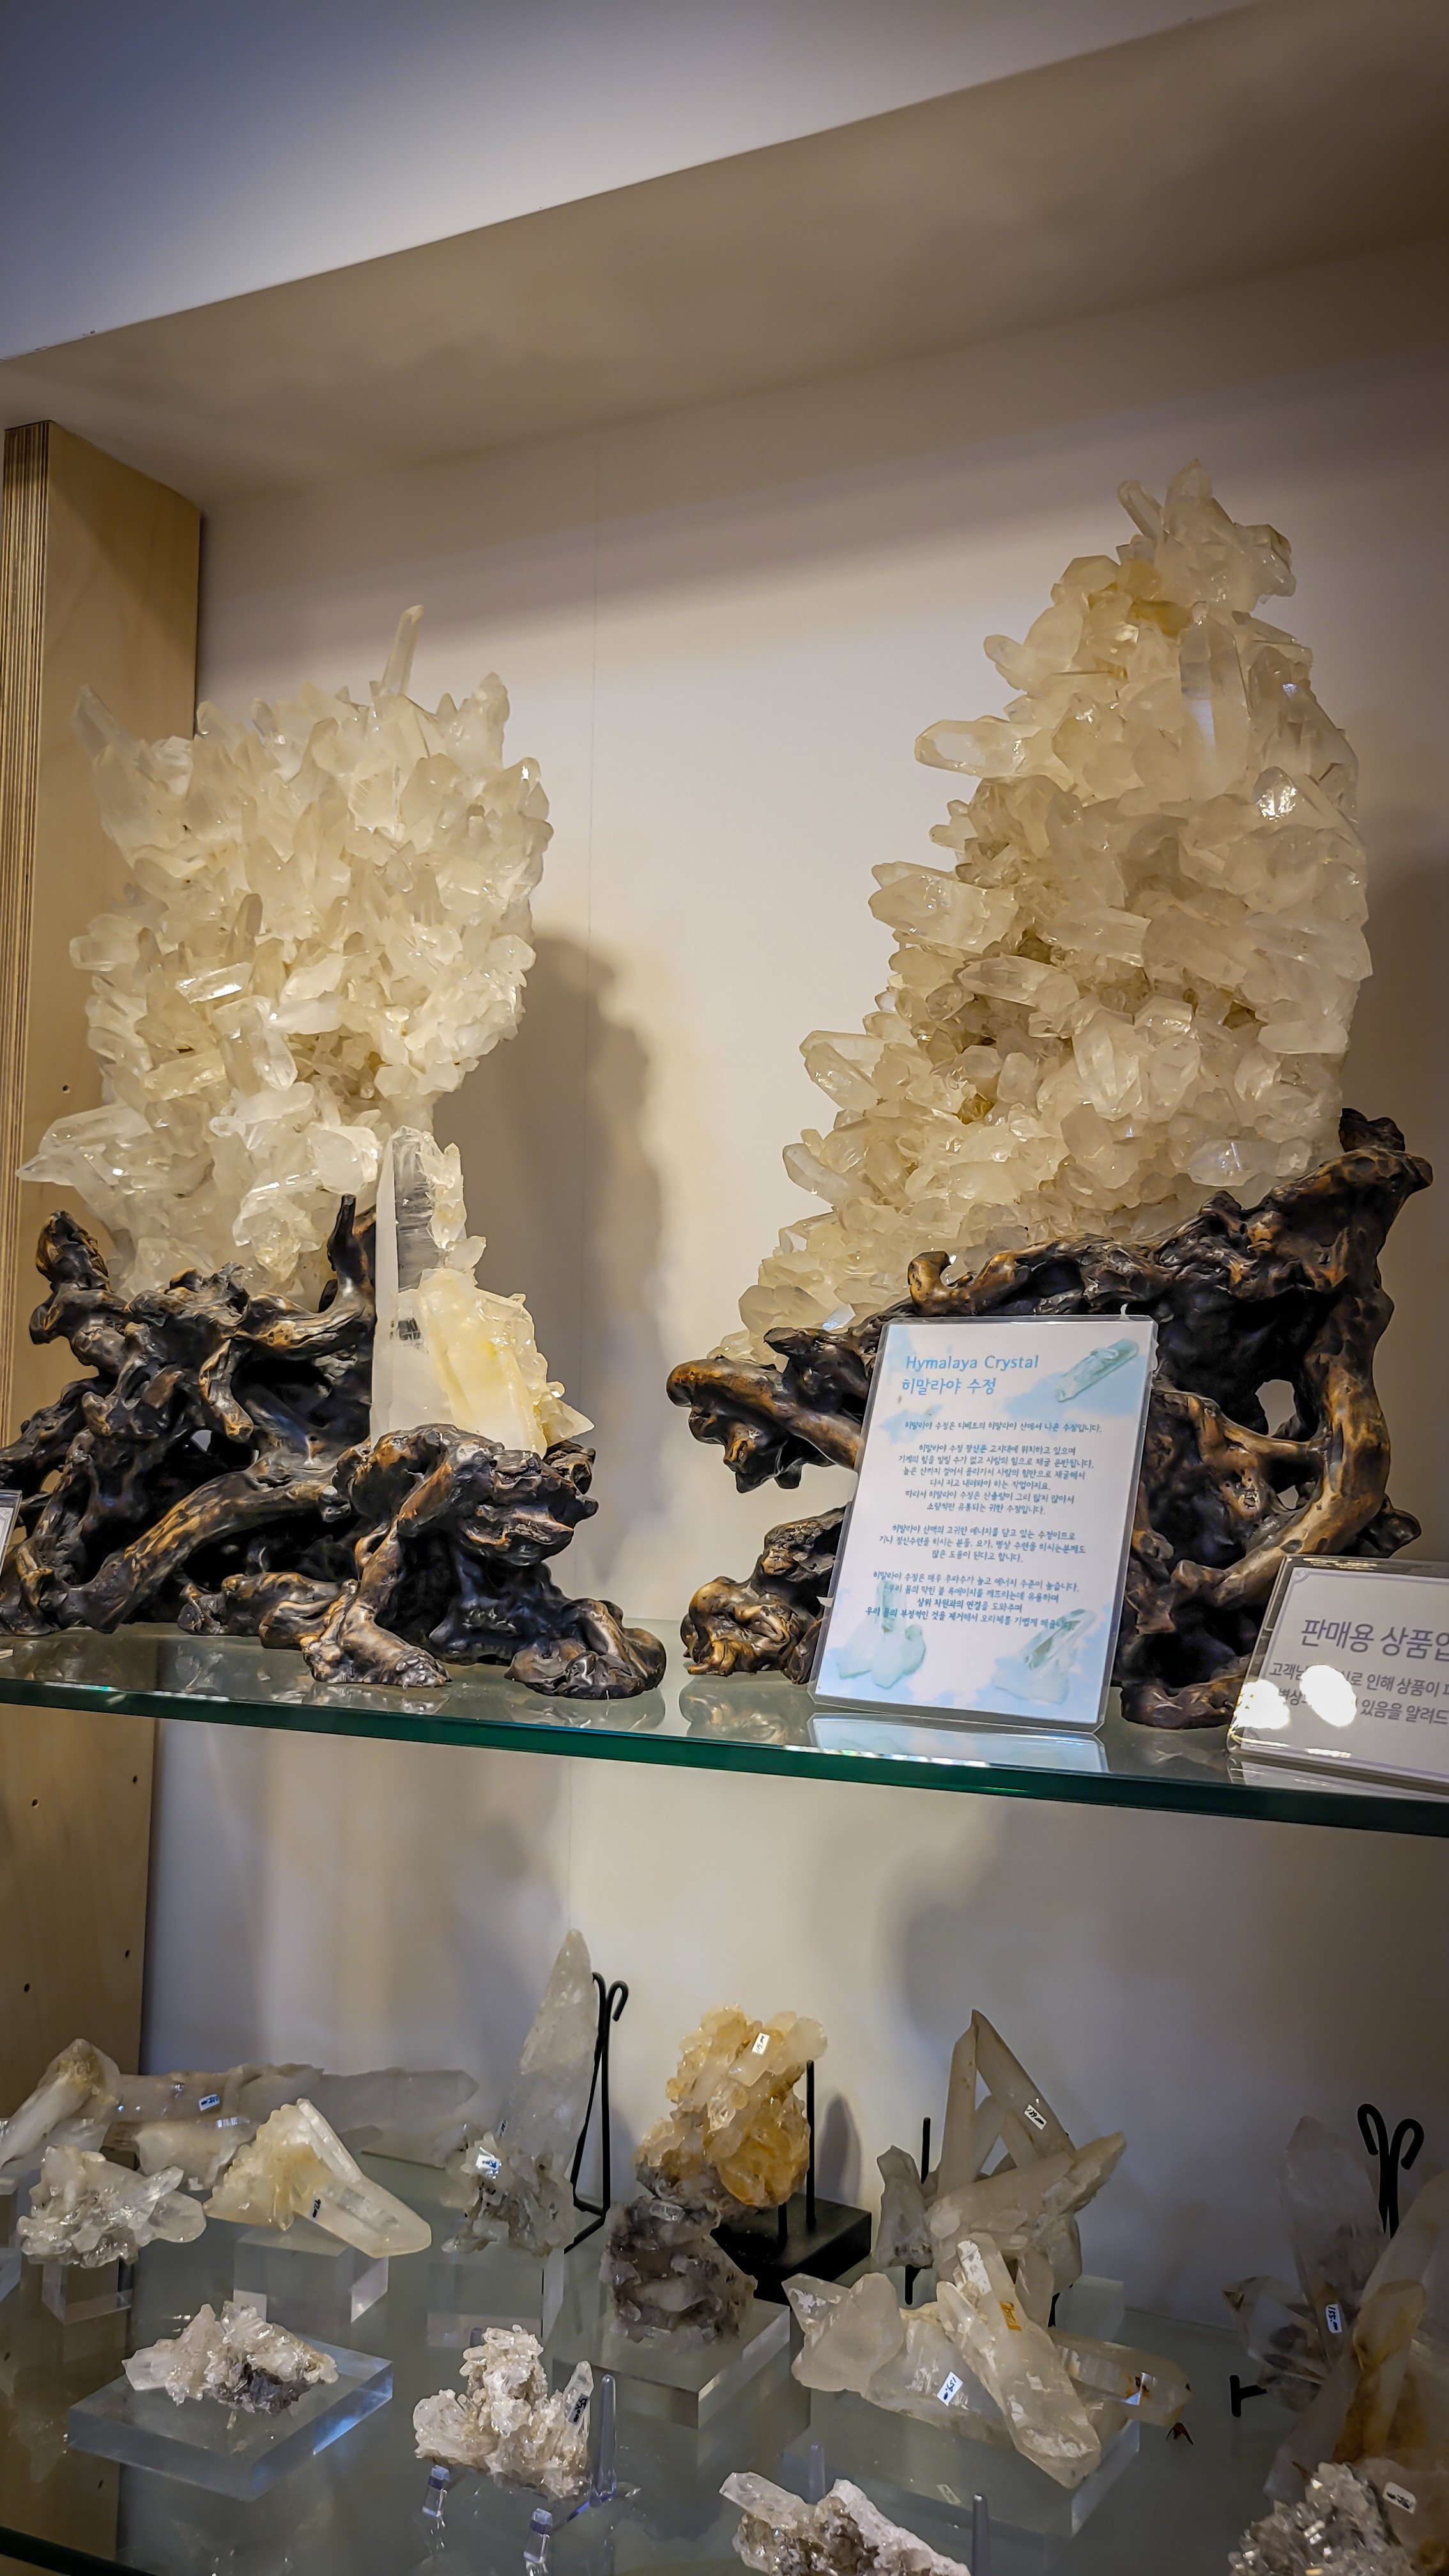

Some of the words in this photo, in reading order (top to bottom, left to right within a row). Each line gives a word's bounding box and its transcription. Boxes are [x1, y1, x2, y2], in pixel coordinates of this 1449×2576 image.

[906, 1356, 977, 1372] Hymalaya
[985, 1355, 1039, 1371] Crystal
[902, 1378, 962, 1395] 히말라야
[967, 1378, 997, 1395] 수정
[958, 1422, 985, 1430] 티베트의
[1020, 1422, 1041, 1430] 산에서
[1063, 1423, 1101, 1432] 수정입니다.
[919, 1444, 947, 1452] 히말라야
[1022, 1446, 1050, 1454] 위치하고
[1054, 1446, 1076, 1455] 있으며
[899, 1455, 919, 1463] 기계의
[922, 1455, 934, 1464] 힘을
[953, 1456, 967, 1464] 수가
[970, 1456, 983, 1464] 없고
[987, 1457, 1008, 1465] 사람의
[1011, 1457, 1032, 1466] 힘으로
[903, 1467, 917, 1475] 높은
[943, 1468, 963, 1476] 걸어서
[997, 1468, 1018, 1477] 사람의
[930, 1478, 943, 1487] 다시
[946, 1479, 960, 1487] 지고
[994, 1480, 1008, 1489] 하는
[960, 1491, 980, 1499] 수정은
[1007, 1505, 1045, 1514] 수정입니다.
[1020, 1529, 1034, 1538] 있는
[933, 1538, 953, 1547] 하시는
[996, 1540, 1011, 1549] 명상
[949, 1551, 970, 1559] 도움이
[974, 1551, 995, 1560] 된다고
[905, 1573, 924, 1582] 수정은
[995, 1577, 1017, 1587] 에너지
[1020, 1579, 1043, 1589] 수준이
[888, 1584, 901, 1593] 우리
[905, 1585, 918, 1594] 몸의
[917, 1598, 931, 1607] 상위
[967, 1601, 988, 1611] 연결을
[866, 1607, 880, 1616] 우리
[1301, 1619, 1374, 1653] 판매용
[1367, 1673, 1395, 1692] 인해
[1397, 1678, 1440, 1698] 상품이
[1360, 1698, 1402, 1720] 있음을
